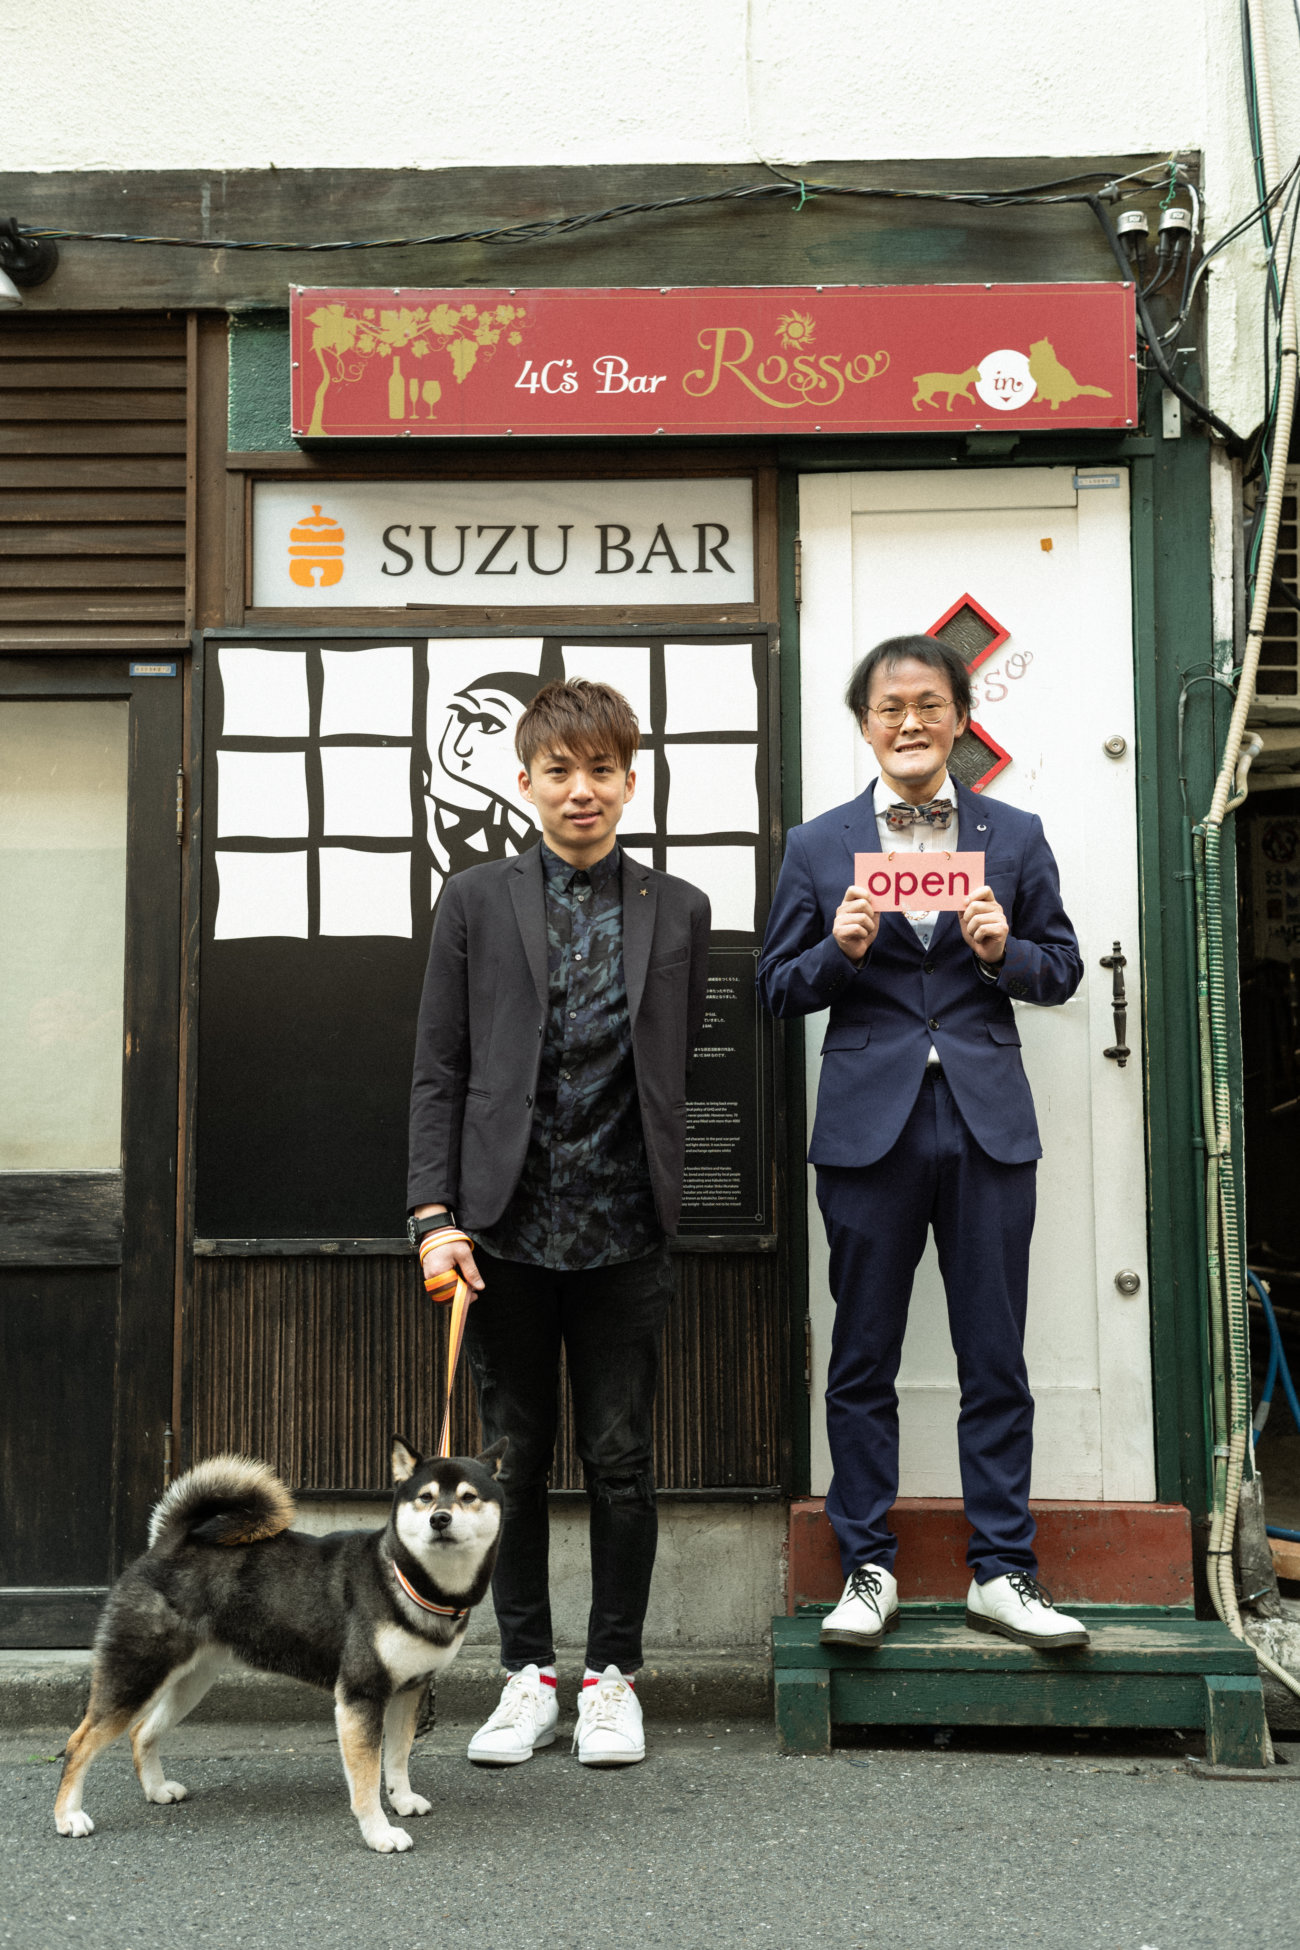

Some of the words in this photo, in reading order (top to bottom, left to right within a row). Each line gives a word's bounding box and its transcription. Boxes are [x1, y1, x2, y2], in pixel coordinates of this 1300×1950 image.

[514, 359, 579, 394] 4C's
[592, 355, 667, 394] Bar
[682, 327, 890, 408] Rosso
[993, 371, 1024, 393] in
[381, 524, 575, 576] SUZU
[594, 522, 735, 574] BAR
[868, 871, 970, 906] open
